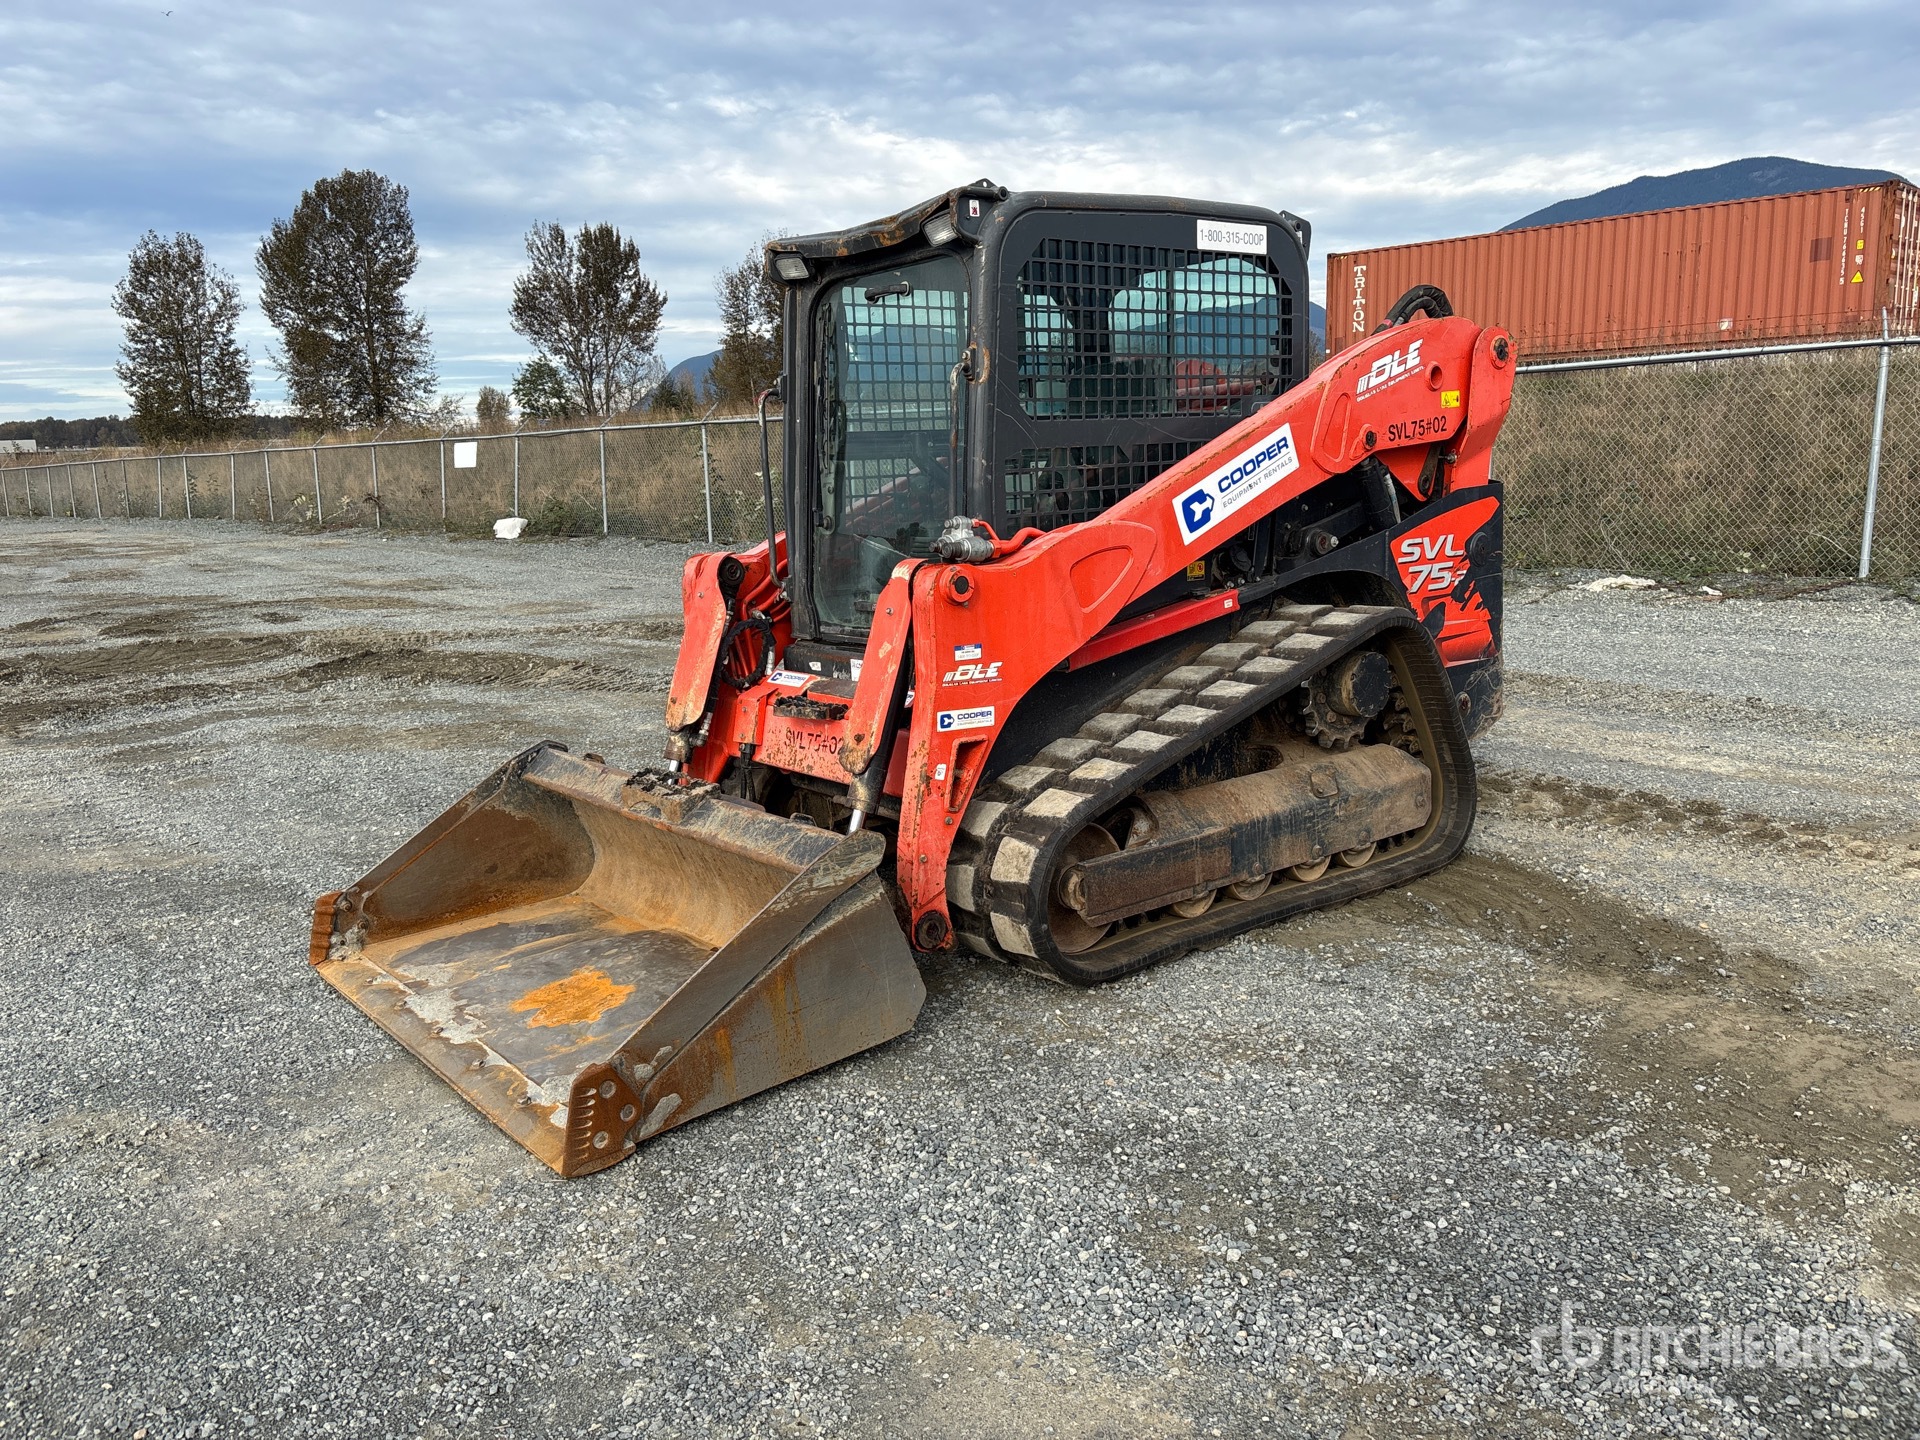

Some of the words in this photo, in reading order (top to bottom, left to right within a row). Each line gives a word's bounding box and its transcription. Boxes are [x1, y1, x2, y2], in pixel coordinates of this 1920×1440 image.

[1200, 228, 1265, 246] 1-800-315-COOP
[1352, 265, 1367, 332] TRITON
[1388, 415, 1448, 442] SVL75#02
[1217, 436, 1290, 493] COOPER
[1222, 476, 1263, 509] EQUIPMENT
[1263, 456, 1293, 480] RENTALS
[1397, 534, 1464, 564] SVL
[957, 710, 992, 720] COOPER
